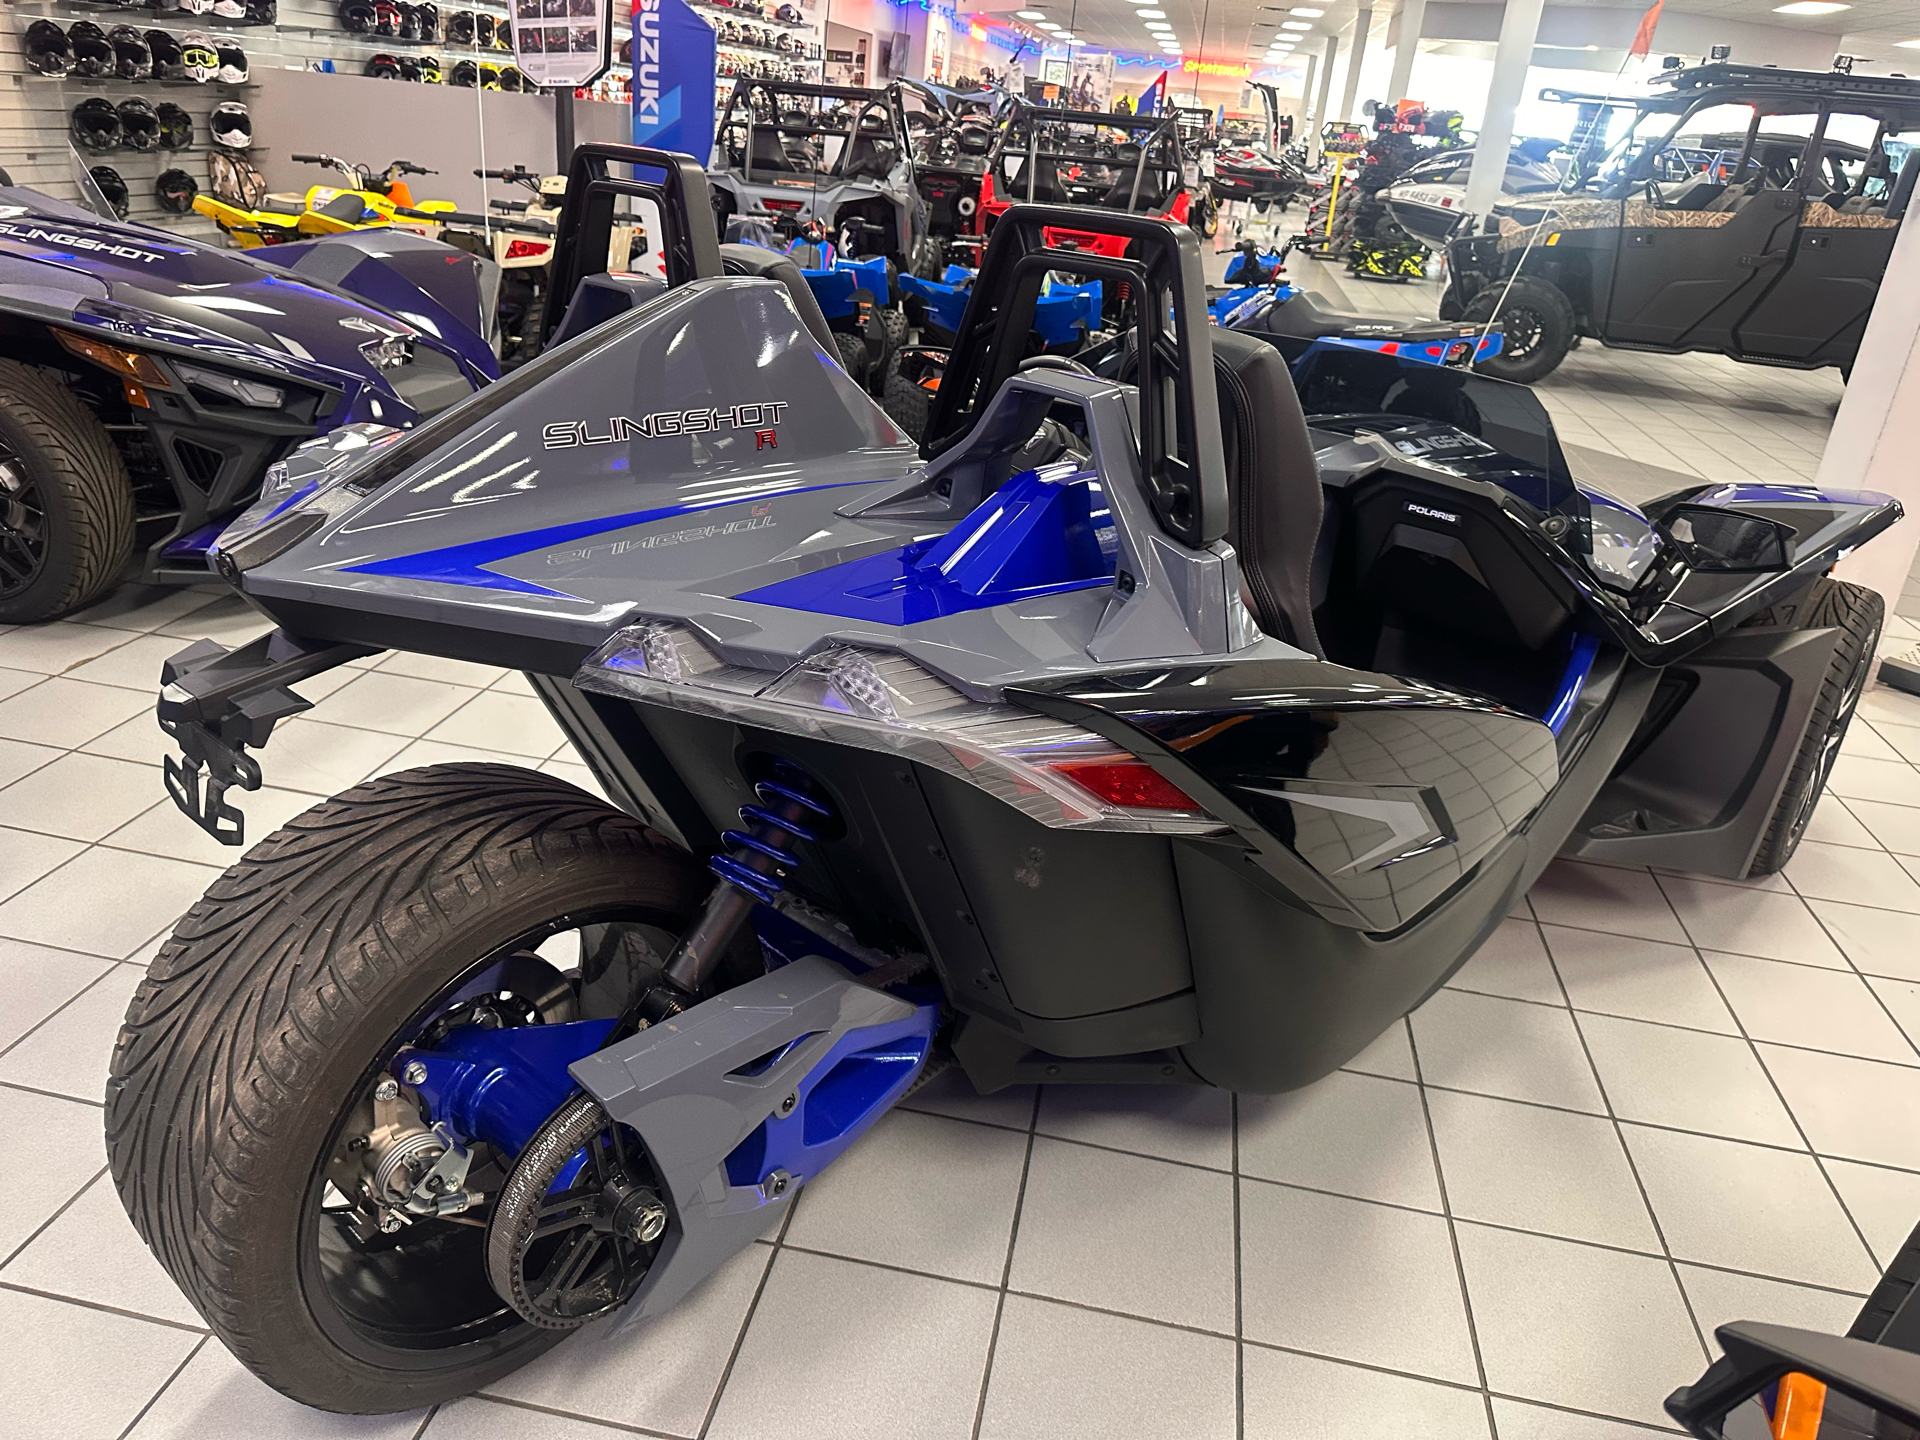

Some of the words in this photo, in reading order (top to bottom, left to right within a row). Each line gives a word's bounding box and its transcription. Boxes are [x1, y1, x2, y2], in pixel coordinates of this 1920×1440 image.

[1184, 60, 1252, 77] SPORTSWEAR
[0, 223, 165, 263] SLINGSHOT
[542, 401, 788, 450] SLINGSHOT
[755, 429, 778, 450] R
[1394, 432, 1476, 455] SLINGSHO
[1407, 503, 1456, 522] POLARIS
